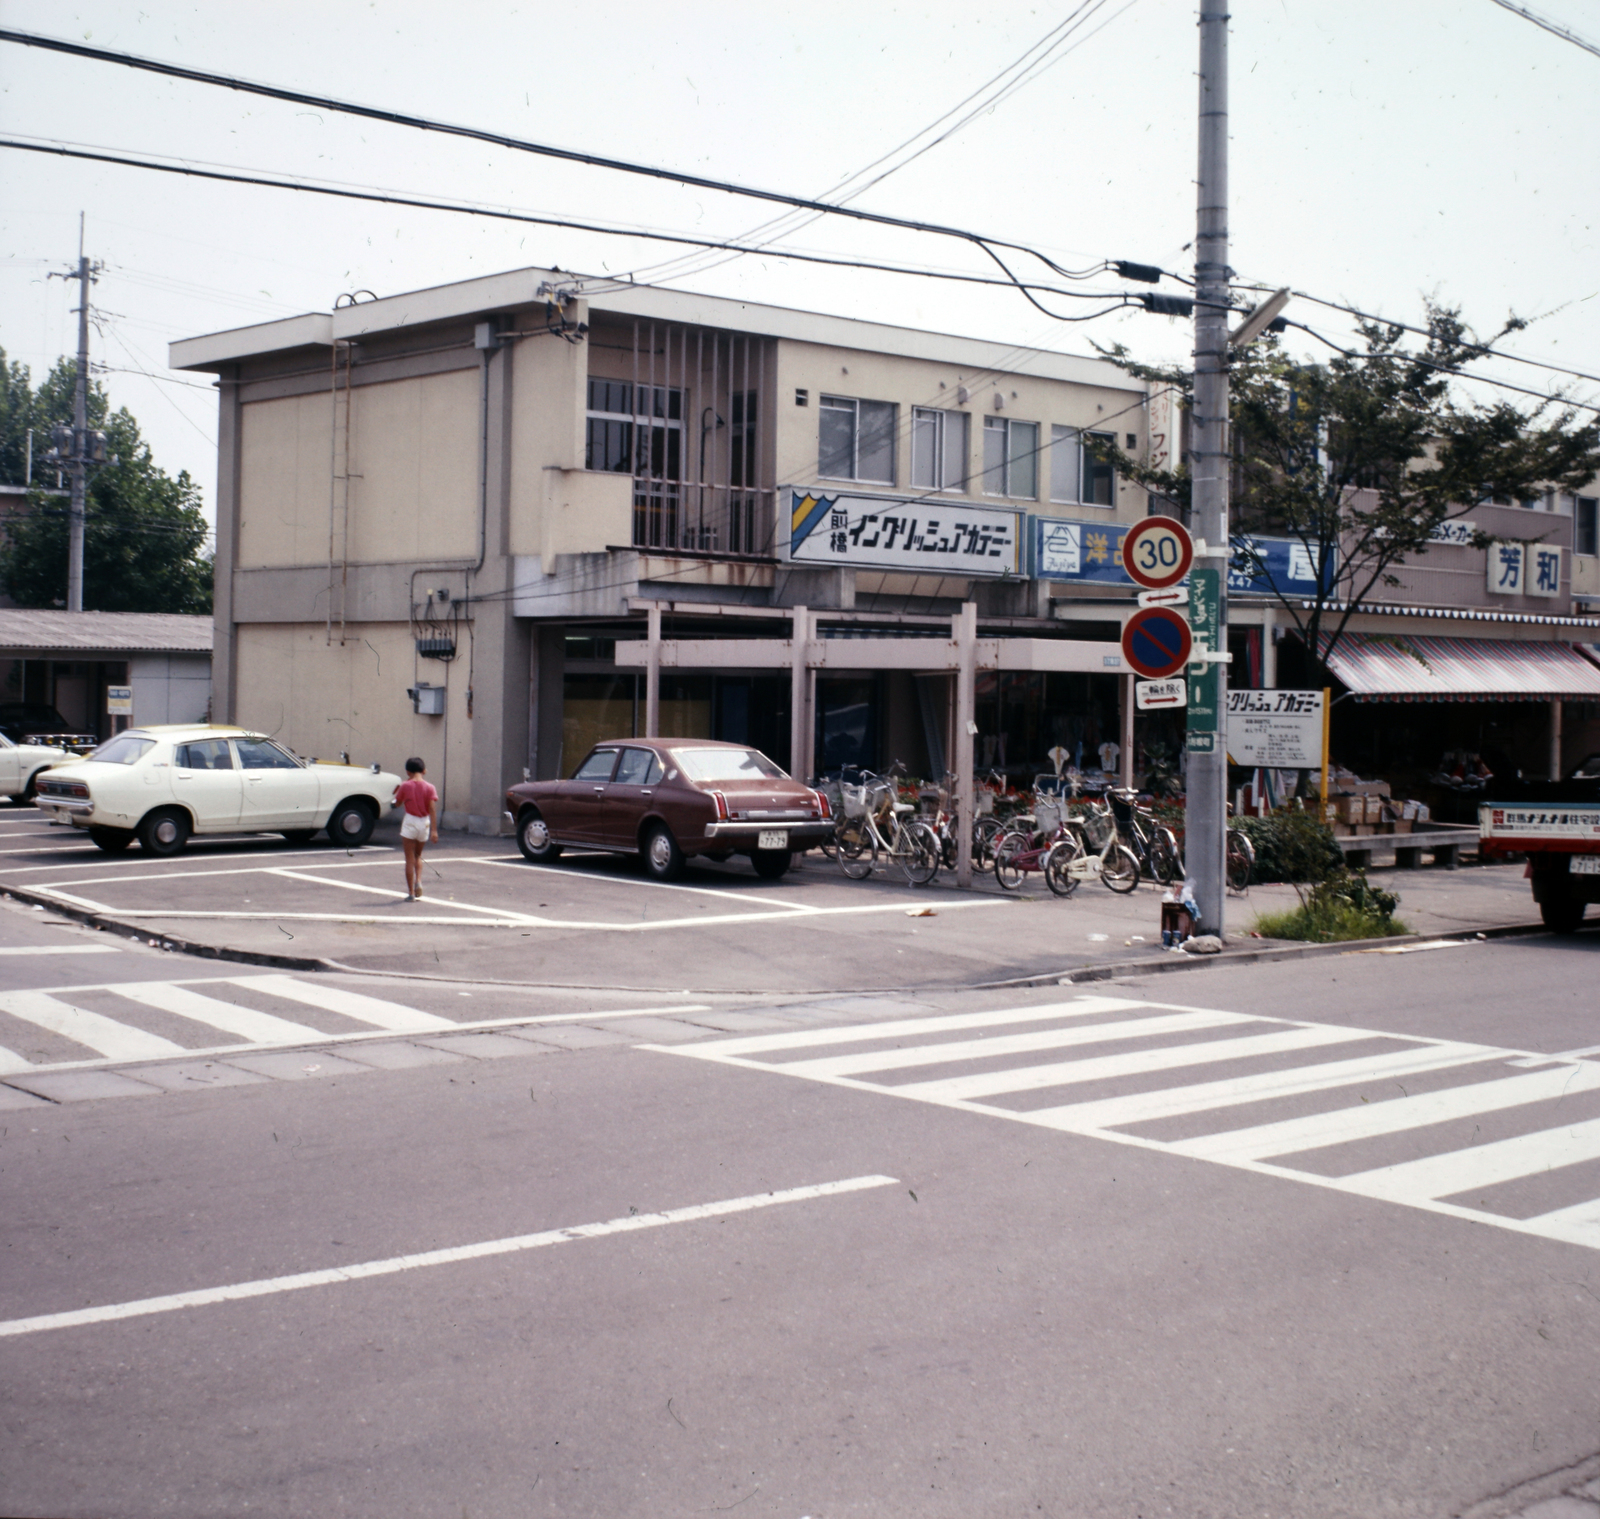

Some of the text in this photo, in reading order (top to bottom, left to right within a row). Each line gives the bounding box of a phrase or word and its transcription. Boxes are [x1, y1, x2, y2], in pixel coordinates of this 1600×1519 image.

[830, 508, 848, 553] 前橋
[1139, 536, 1178, 570] 30
[1497, 546, 1560, 592] 芳和
[1227, 692, 1321, 713] グリッシュ アカデミー
